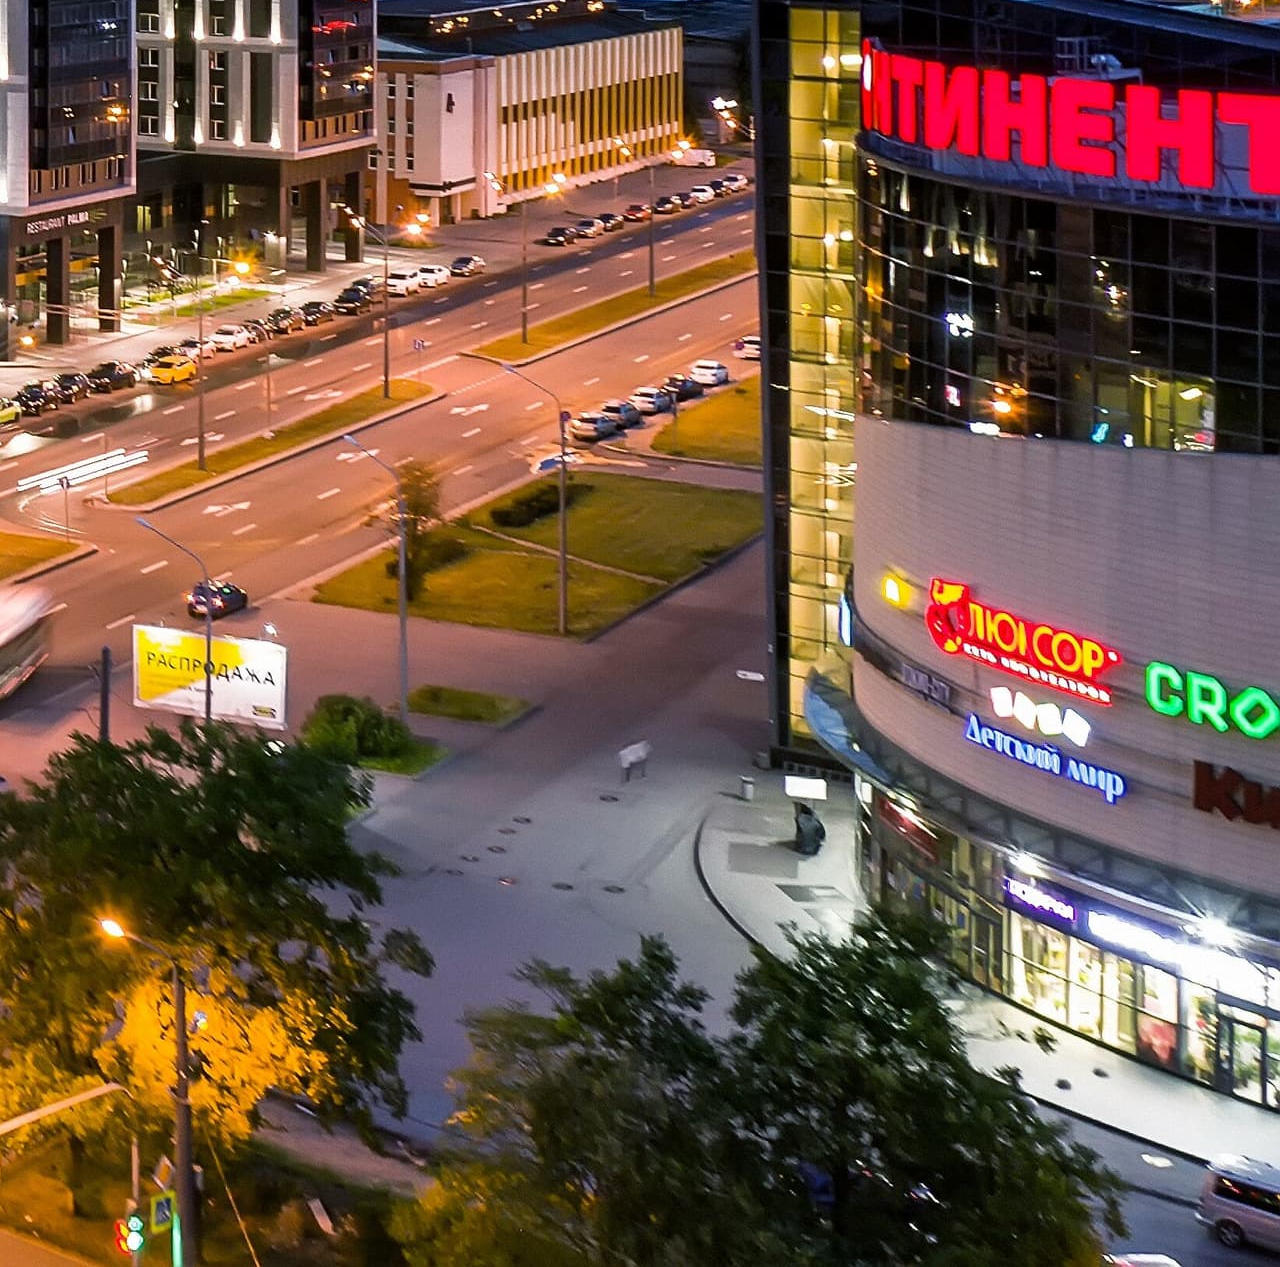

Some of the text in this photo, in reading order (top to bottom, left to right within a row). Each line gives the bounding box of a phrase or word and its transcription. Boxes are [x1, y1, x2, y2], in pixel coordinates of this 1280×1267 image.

[862, 37, 1280, 196] НТИНЕНТ
[146, 651, 276, 687] РАСПРОДАЖА
[1145, 660, 1280, 741] CRO
[965, 714, 1061, 775] Детский
[1067, 758, 1124, 804] мир
